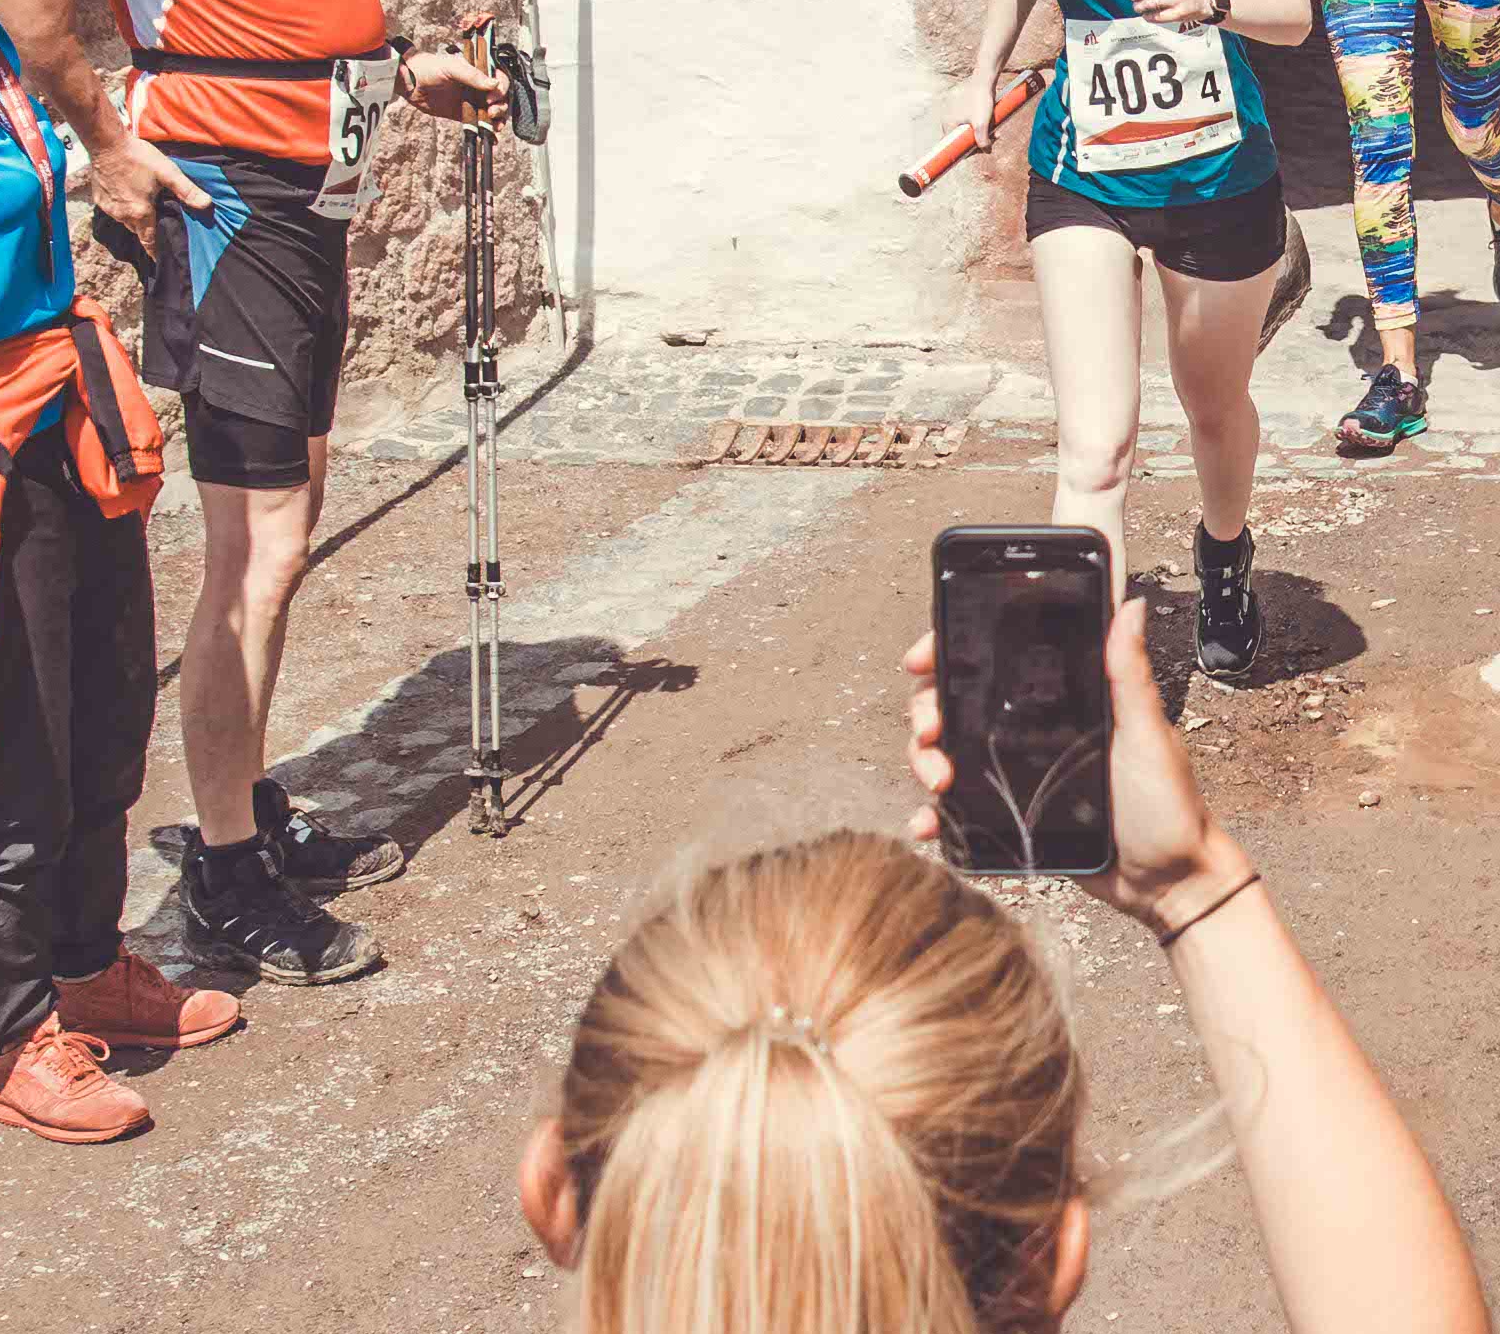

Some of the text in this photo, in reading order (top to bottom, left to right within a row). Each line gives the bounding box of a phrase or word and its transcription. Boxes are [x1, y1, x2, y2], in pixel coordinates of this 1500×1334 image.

[1089, 53, 1221, 116] 403 4
[341, 100, 389, 167] 50
